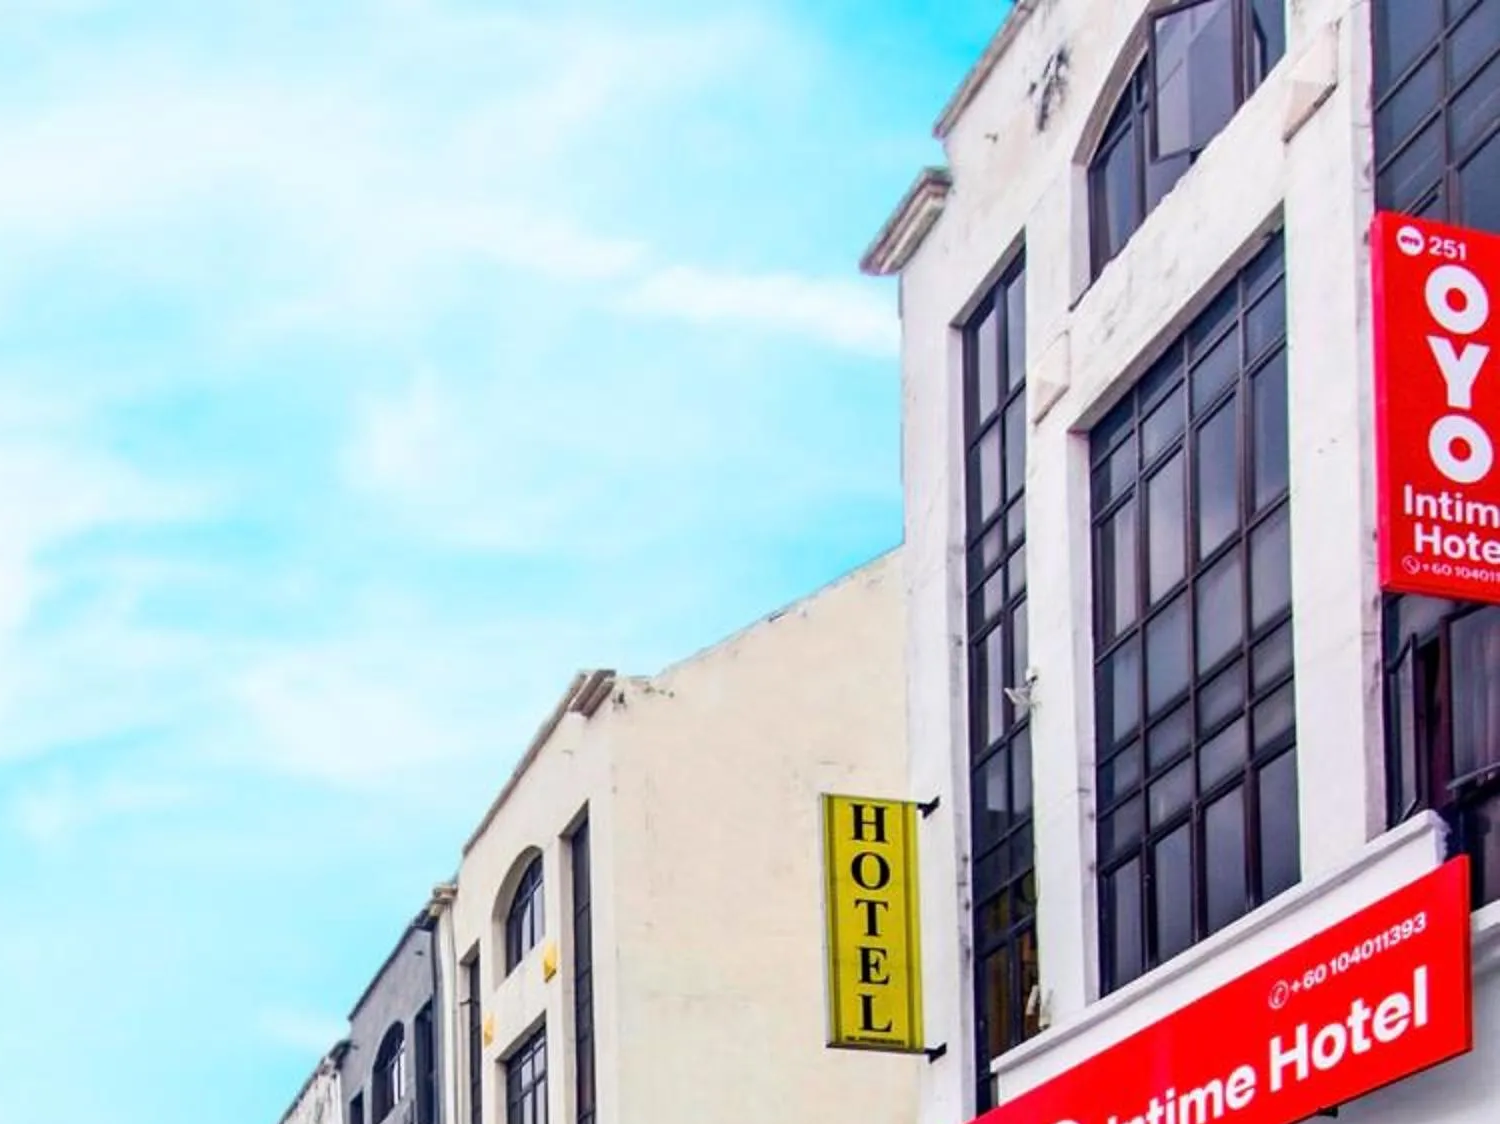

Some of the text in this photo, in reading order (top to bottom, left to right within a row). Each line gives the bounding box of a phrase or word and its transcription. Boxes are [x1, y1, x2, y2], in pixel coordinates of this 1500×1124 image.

[1428, 235, 1467, 262] 251
[1424, 264, 1494, 484] OYO
[1414, 521, 1500, 565] Hote
[850, 802, 893, 1033] HOTEL
[1290, 911, 1427, 993] +60 104011393
[1269, 964, 1429, 1093] Hotel
